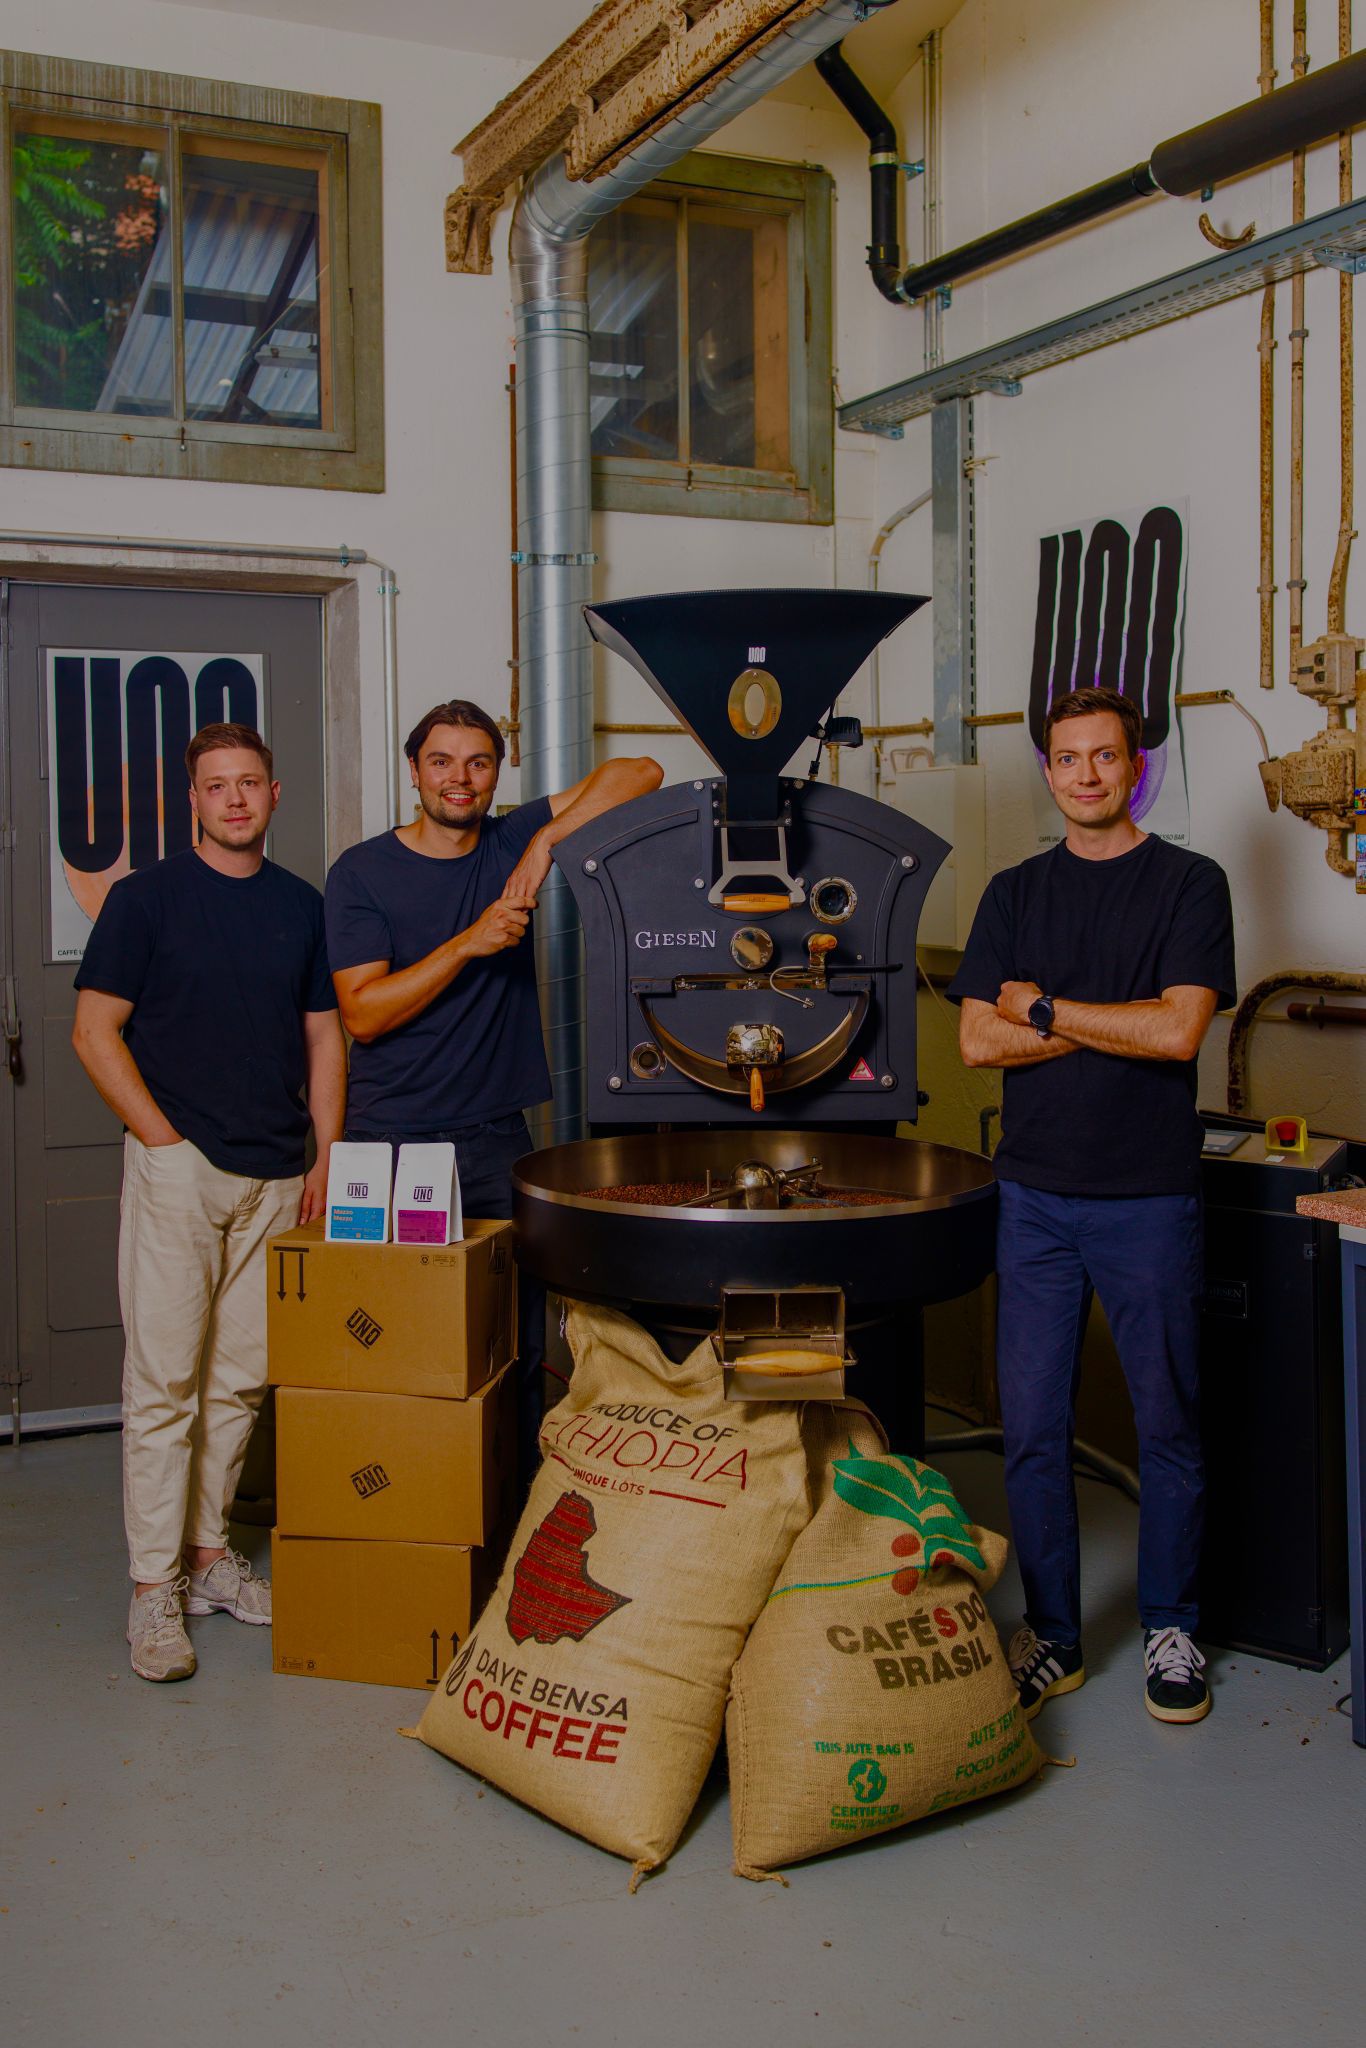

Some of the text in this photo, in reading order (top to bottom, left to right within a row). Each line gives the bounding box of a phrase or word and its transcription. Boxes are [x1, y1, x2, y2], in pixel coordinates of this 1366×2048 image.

[747, 646, 766, 663] UNO
[1174, 833, 1185, 841] BAR
[635, 930, 716, 949] GIESEN
[347, 1184, 369, 1197] UNO
[413, 1188, 433, 1200] UNO
[346, 1310, 381, 1346] UNO
[591, 1404, 738, 1443] RODUCE OF
[351, 1464, 390, 1496] UNO
[611, 1479, 645, 1496] LOTS
[826, 1592, 986, 1655] CAFÉS DO
[872, 1636, 993, 1689] BRASIL
[476, 1648, 628, 1721] DAYE BENSA
[463, 1678, 627, 1764] COFFEE
[815, 1741, 915, 1755] THIS JUTE BAG IS
